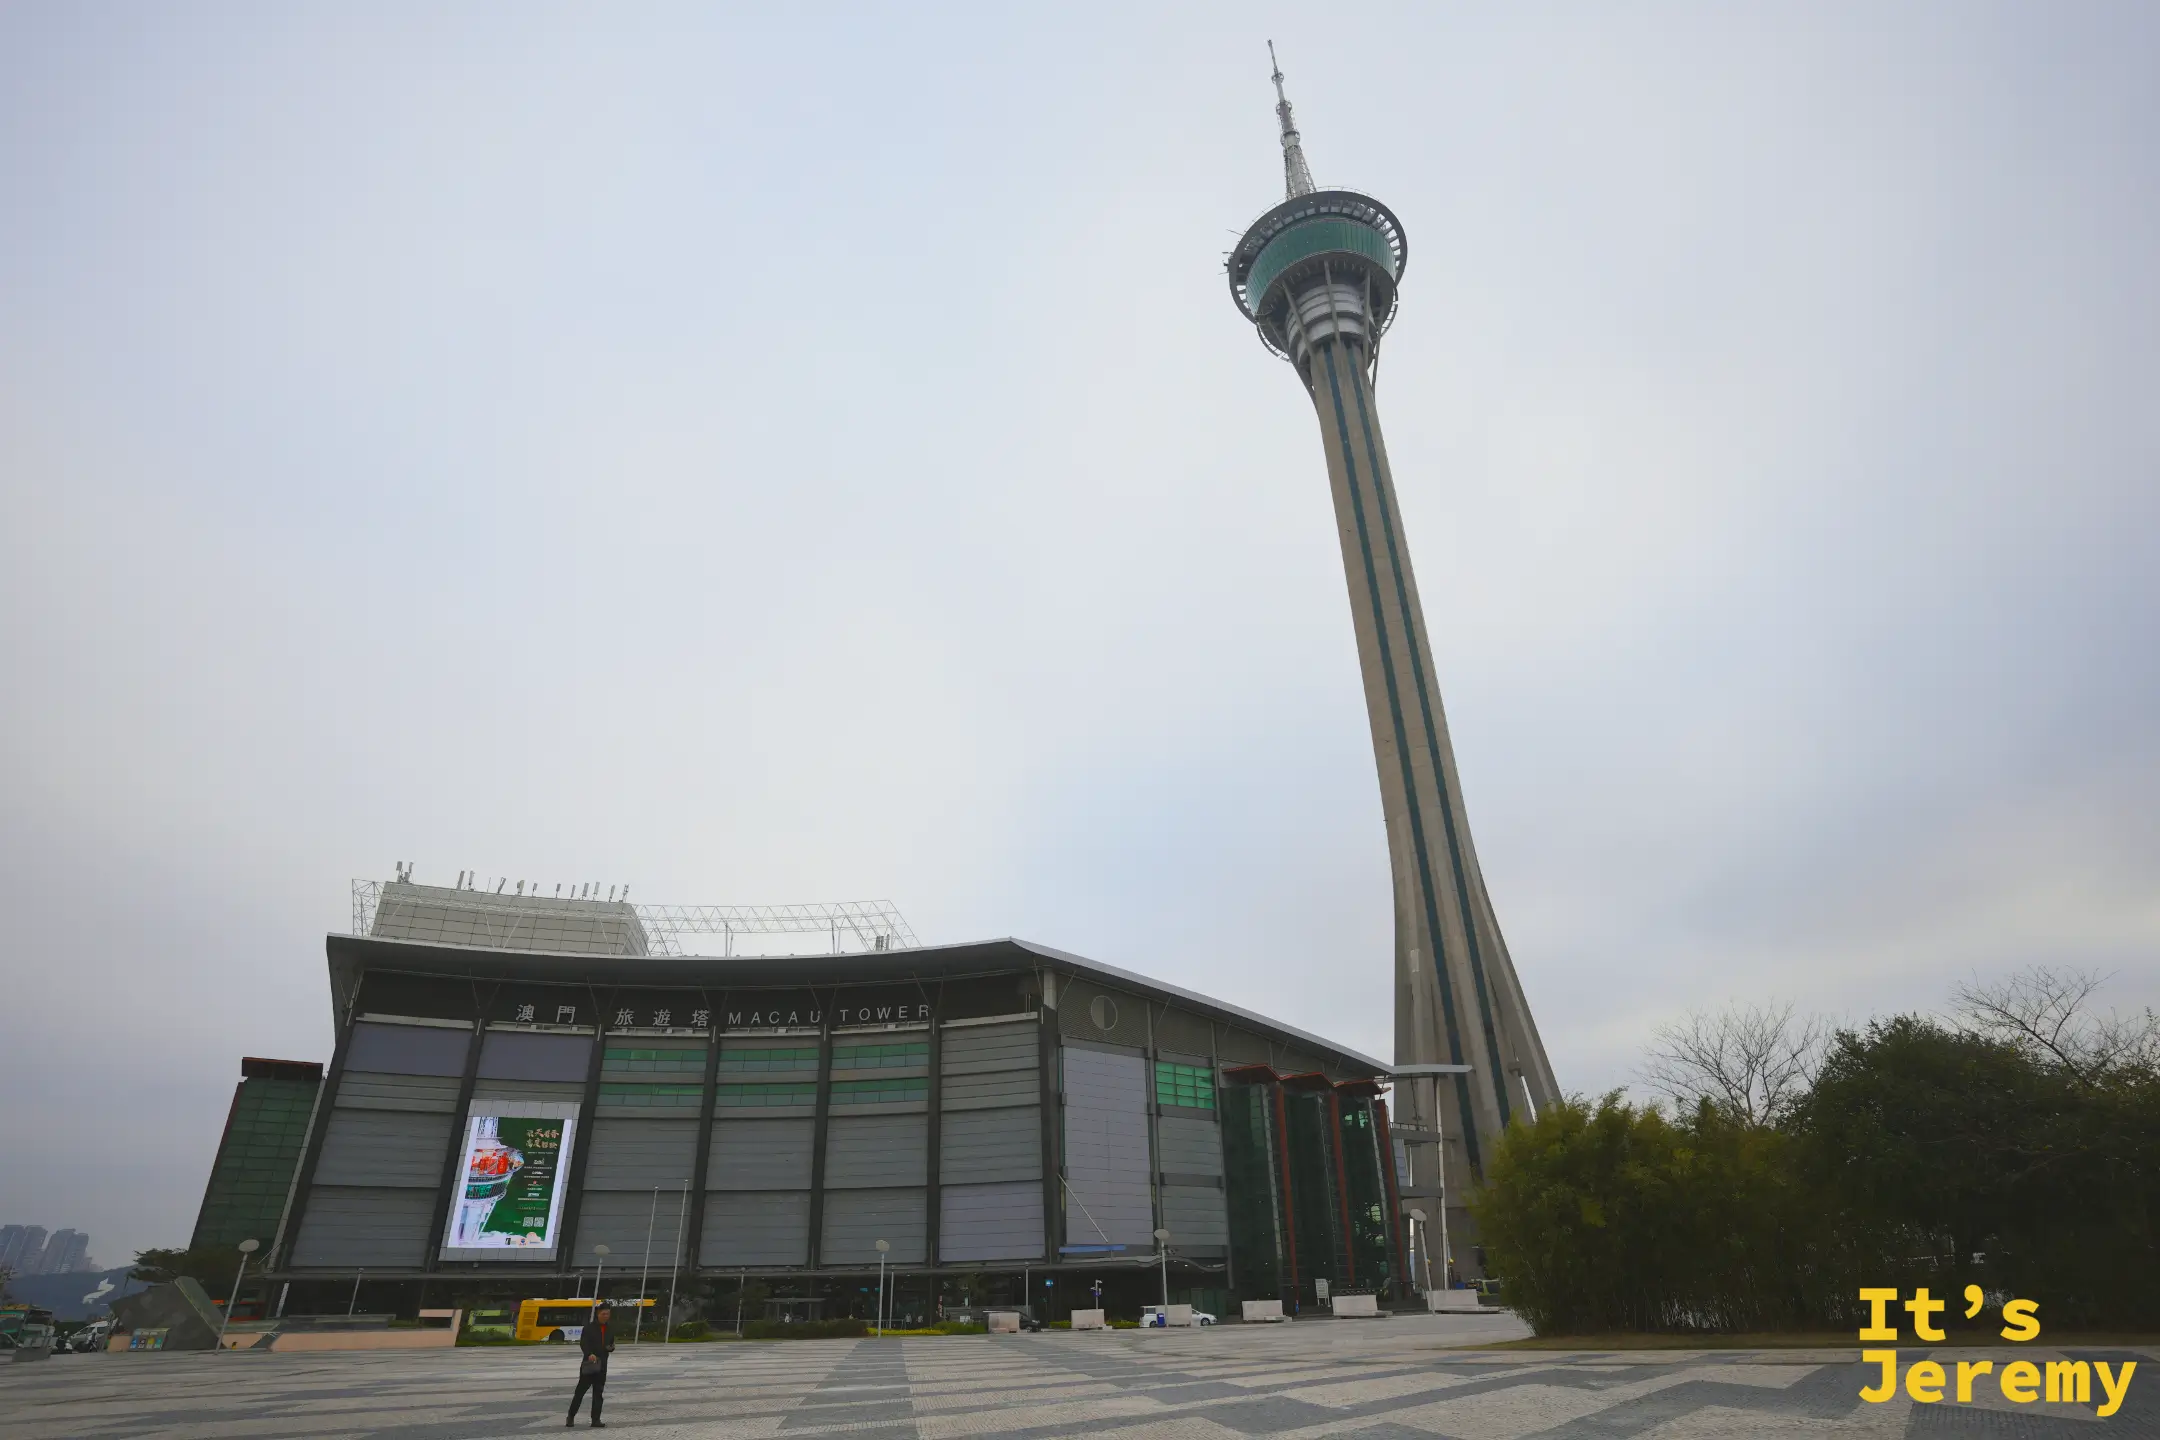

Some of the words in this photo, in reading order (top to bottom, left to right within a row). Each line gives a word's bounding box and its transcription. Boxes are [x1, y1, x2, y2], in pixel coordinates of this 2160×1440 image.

[515, 1003, 711, 1027] 澳門旅遊塔
[728, 1010, 821, 1025] MACAU
[840, 1004, 930, 1022] TOWER
